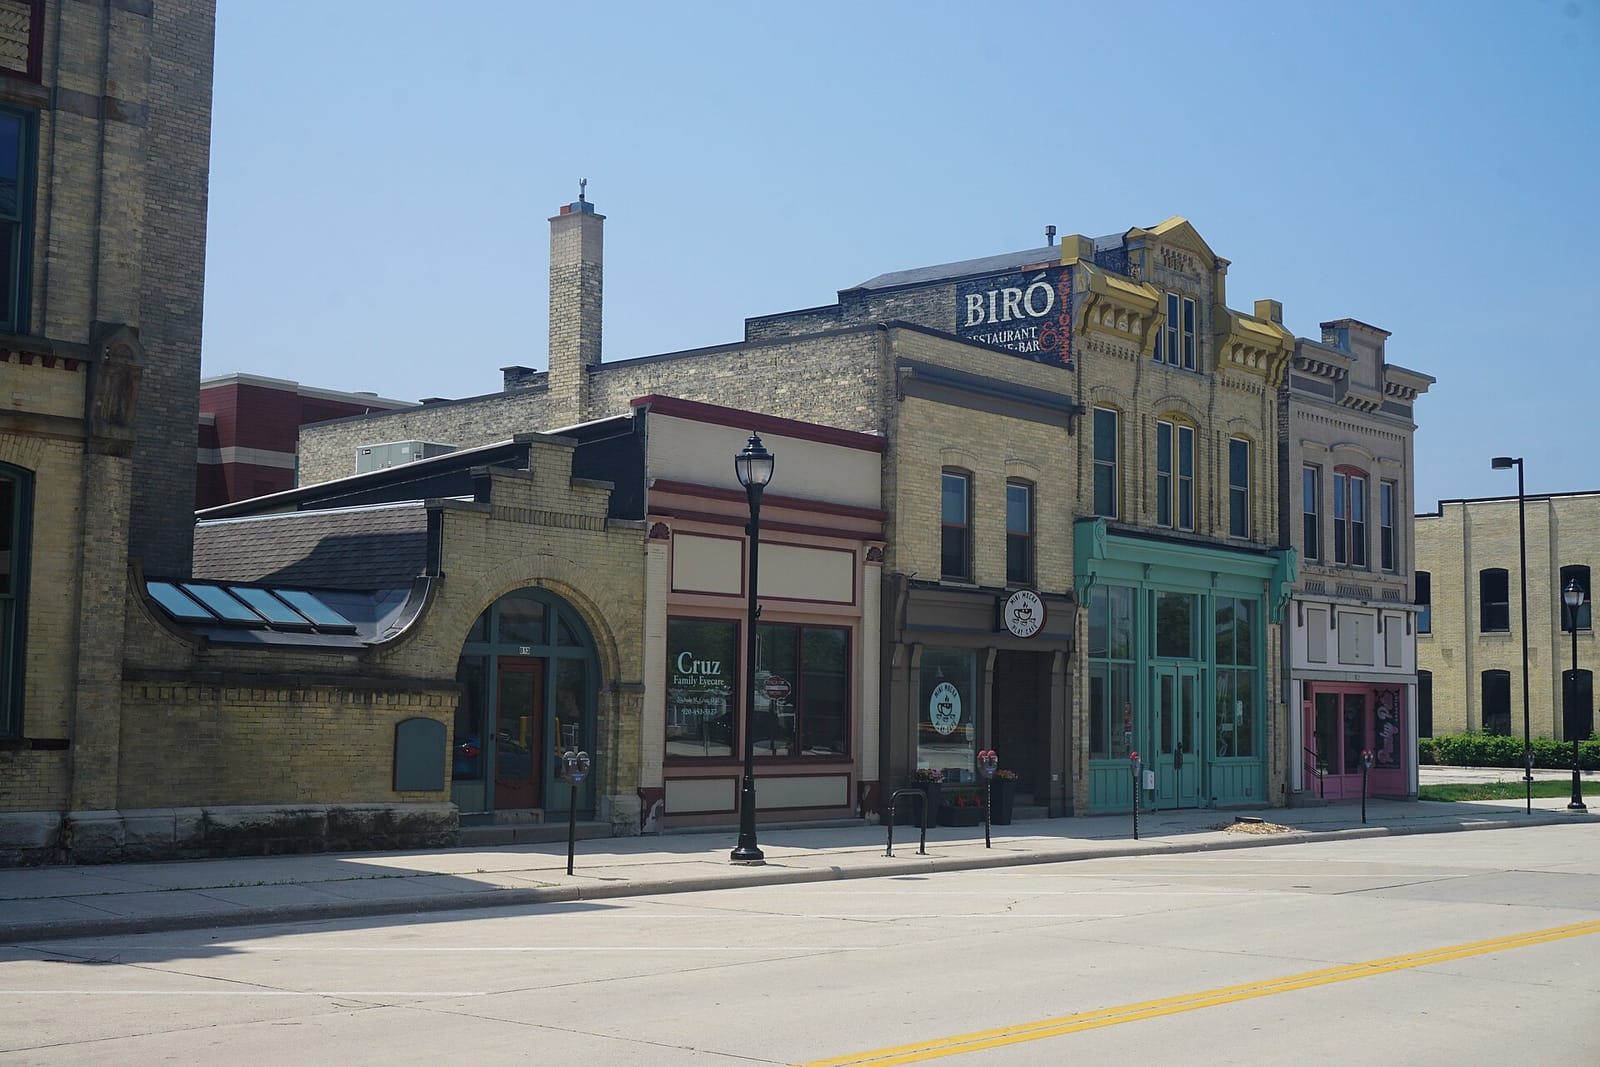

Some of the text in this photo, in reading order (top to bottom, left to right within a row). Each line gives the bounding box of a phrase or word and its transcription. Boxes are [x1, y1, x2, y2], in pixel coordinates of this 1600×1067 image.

[965, 271, 1055, 327] BIRÓ
[1010, 592, 1038, 605] MINI MOCHA
[1011, 625, 1024, 635] PLAY
[677, 651, 721, 675] Cruz
[674, 675, 725, 687] Family Eyecare
